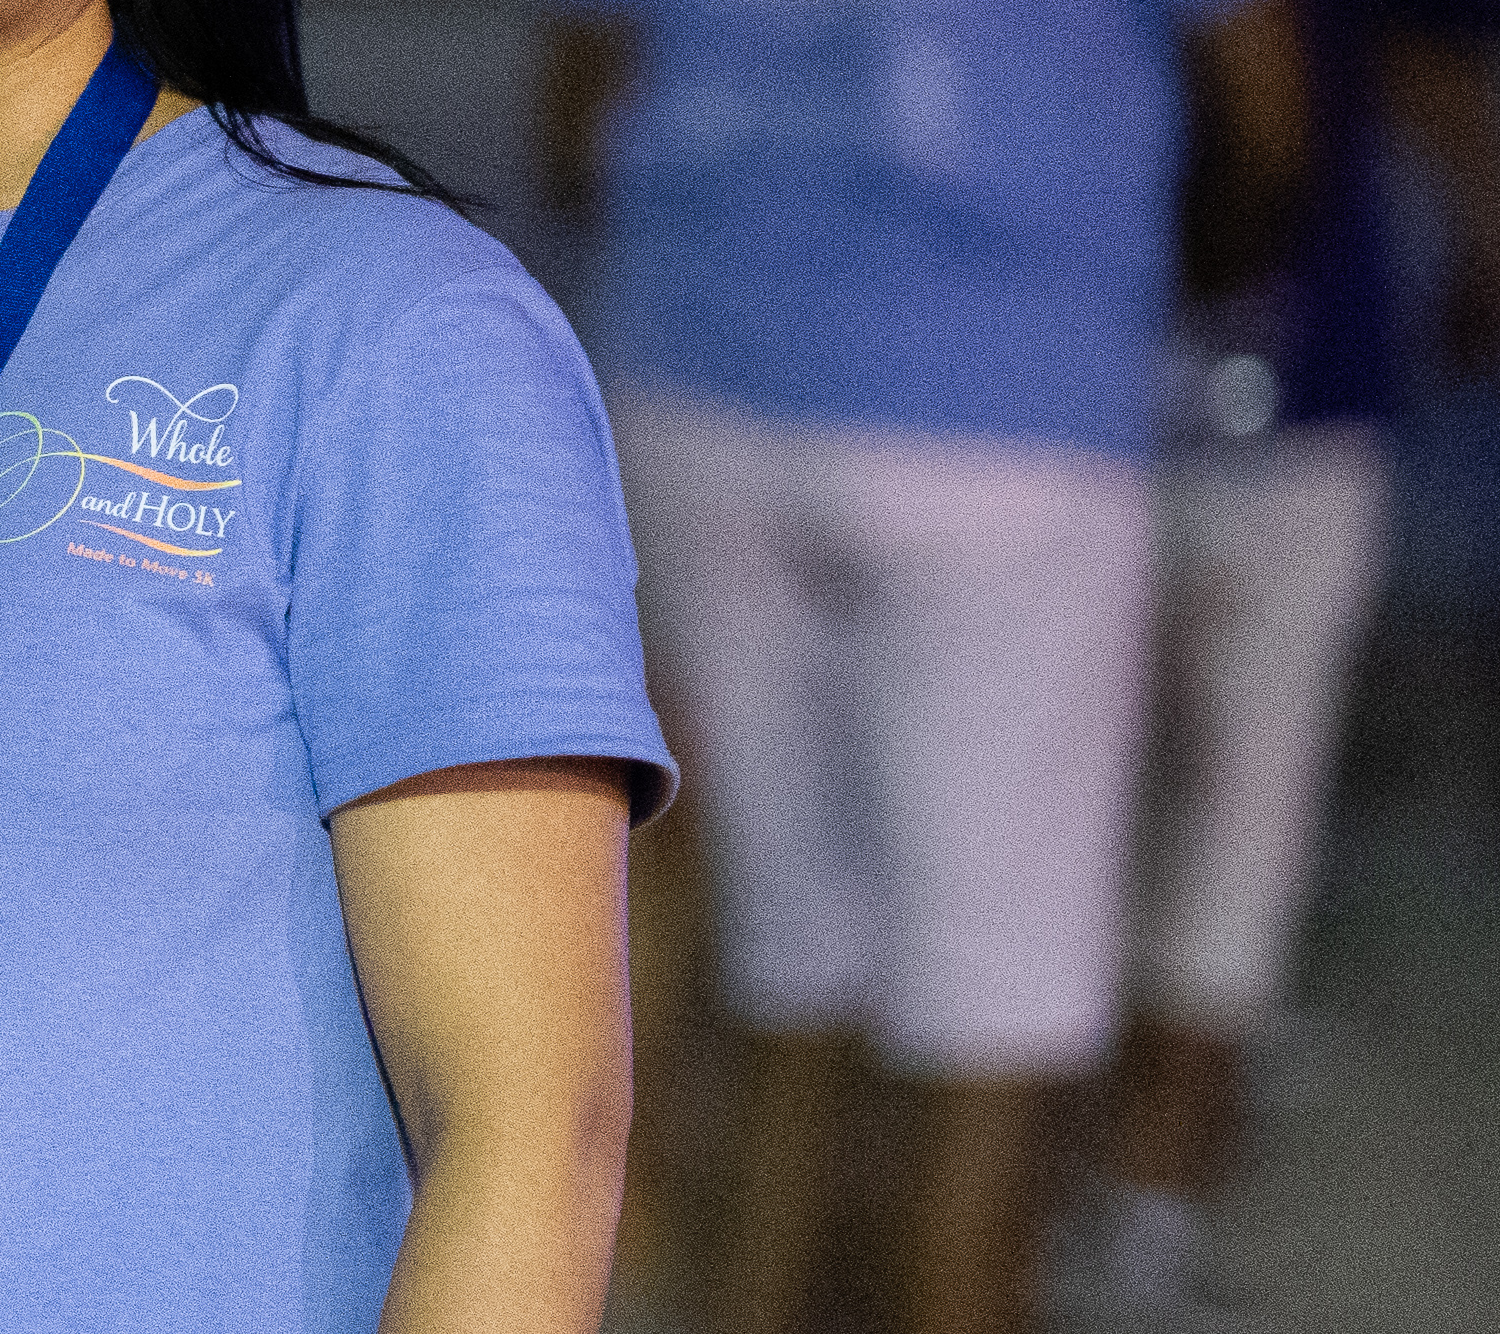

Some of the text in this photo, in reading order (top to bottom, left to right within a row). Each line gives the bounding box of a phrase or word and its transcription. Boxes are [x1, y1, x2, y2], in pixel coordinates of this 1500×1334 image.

[120, 389, 238, 467] Whole
[79, 481, 236, 542] and HOLY
[66, 539, 115, 564] Made
[117, 553, 137, 568] to
[140, 557, 188, 580] Move
